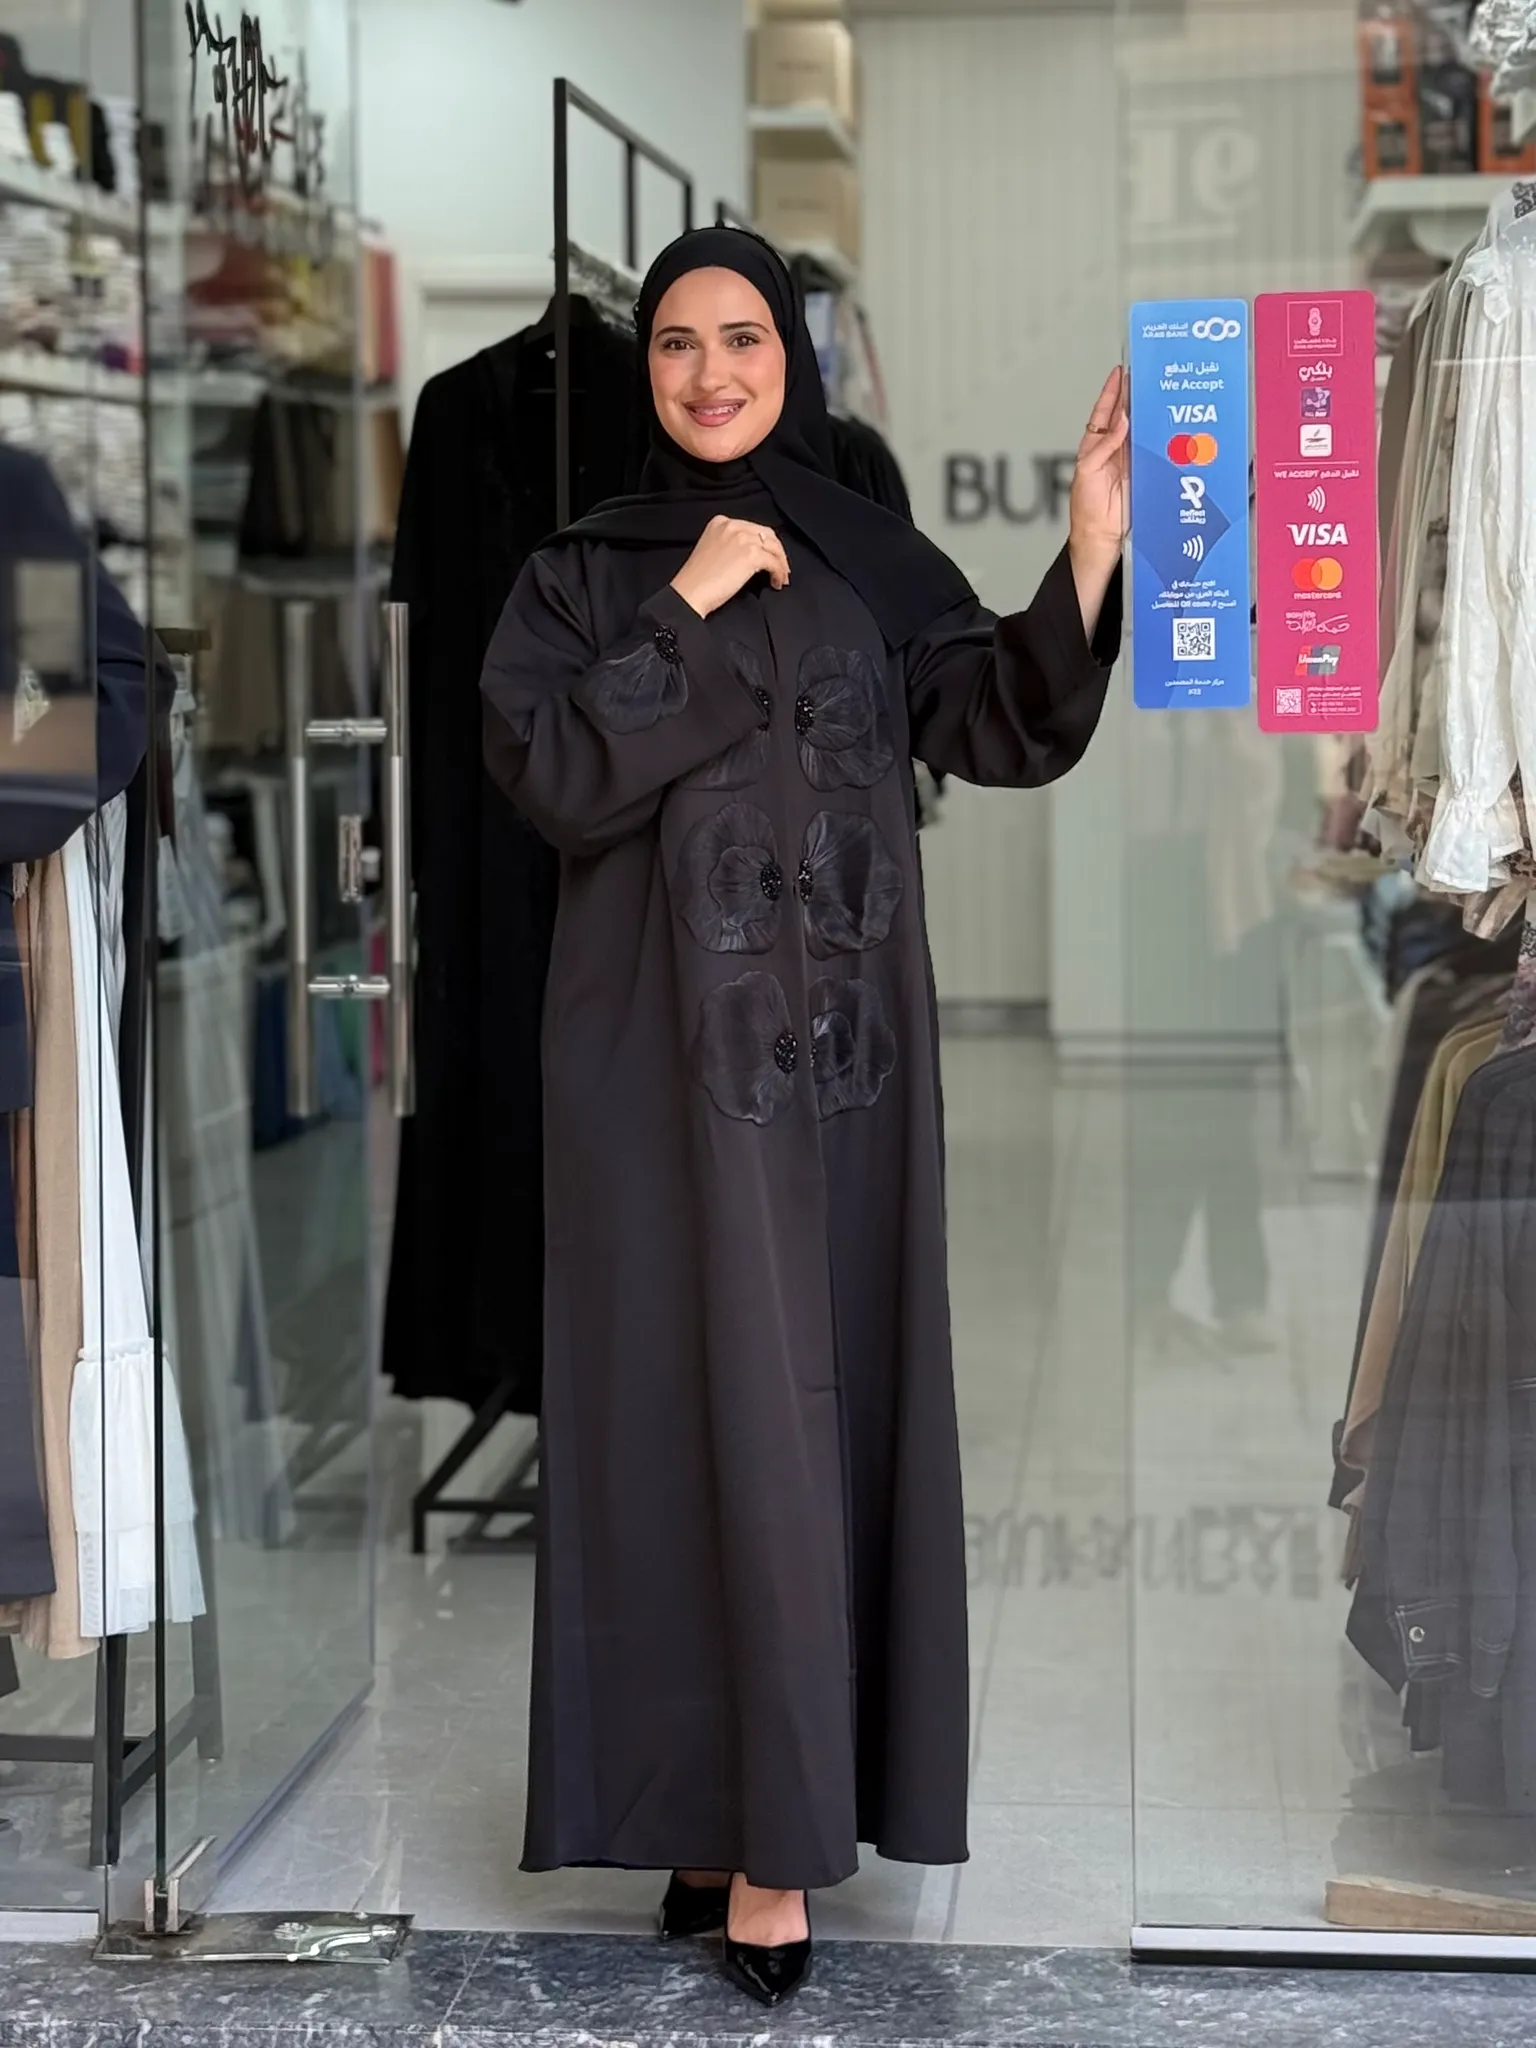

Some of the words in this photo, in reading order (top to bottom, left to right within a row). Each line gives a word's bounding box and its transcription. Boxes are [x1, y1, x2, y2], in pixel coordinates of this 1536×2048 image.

[1164, 361, 1193, 377] الدفع
[1195, 361, 1219, 375] نقبل
[1160, 379, 1180, 391] We
[1181, 379, 1224, 392] Accept
[1168, 404, 1218, 424] VISA
[1273, 470, 1287, 478] WE
[1288, 470, 1319, 478] ACCEPT
[1287, 523, 1348, 546] VISA
